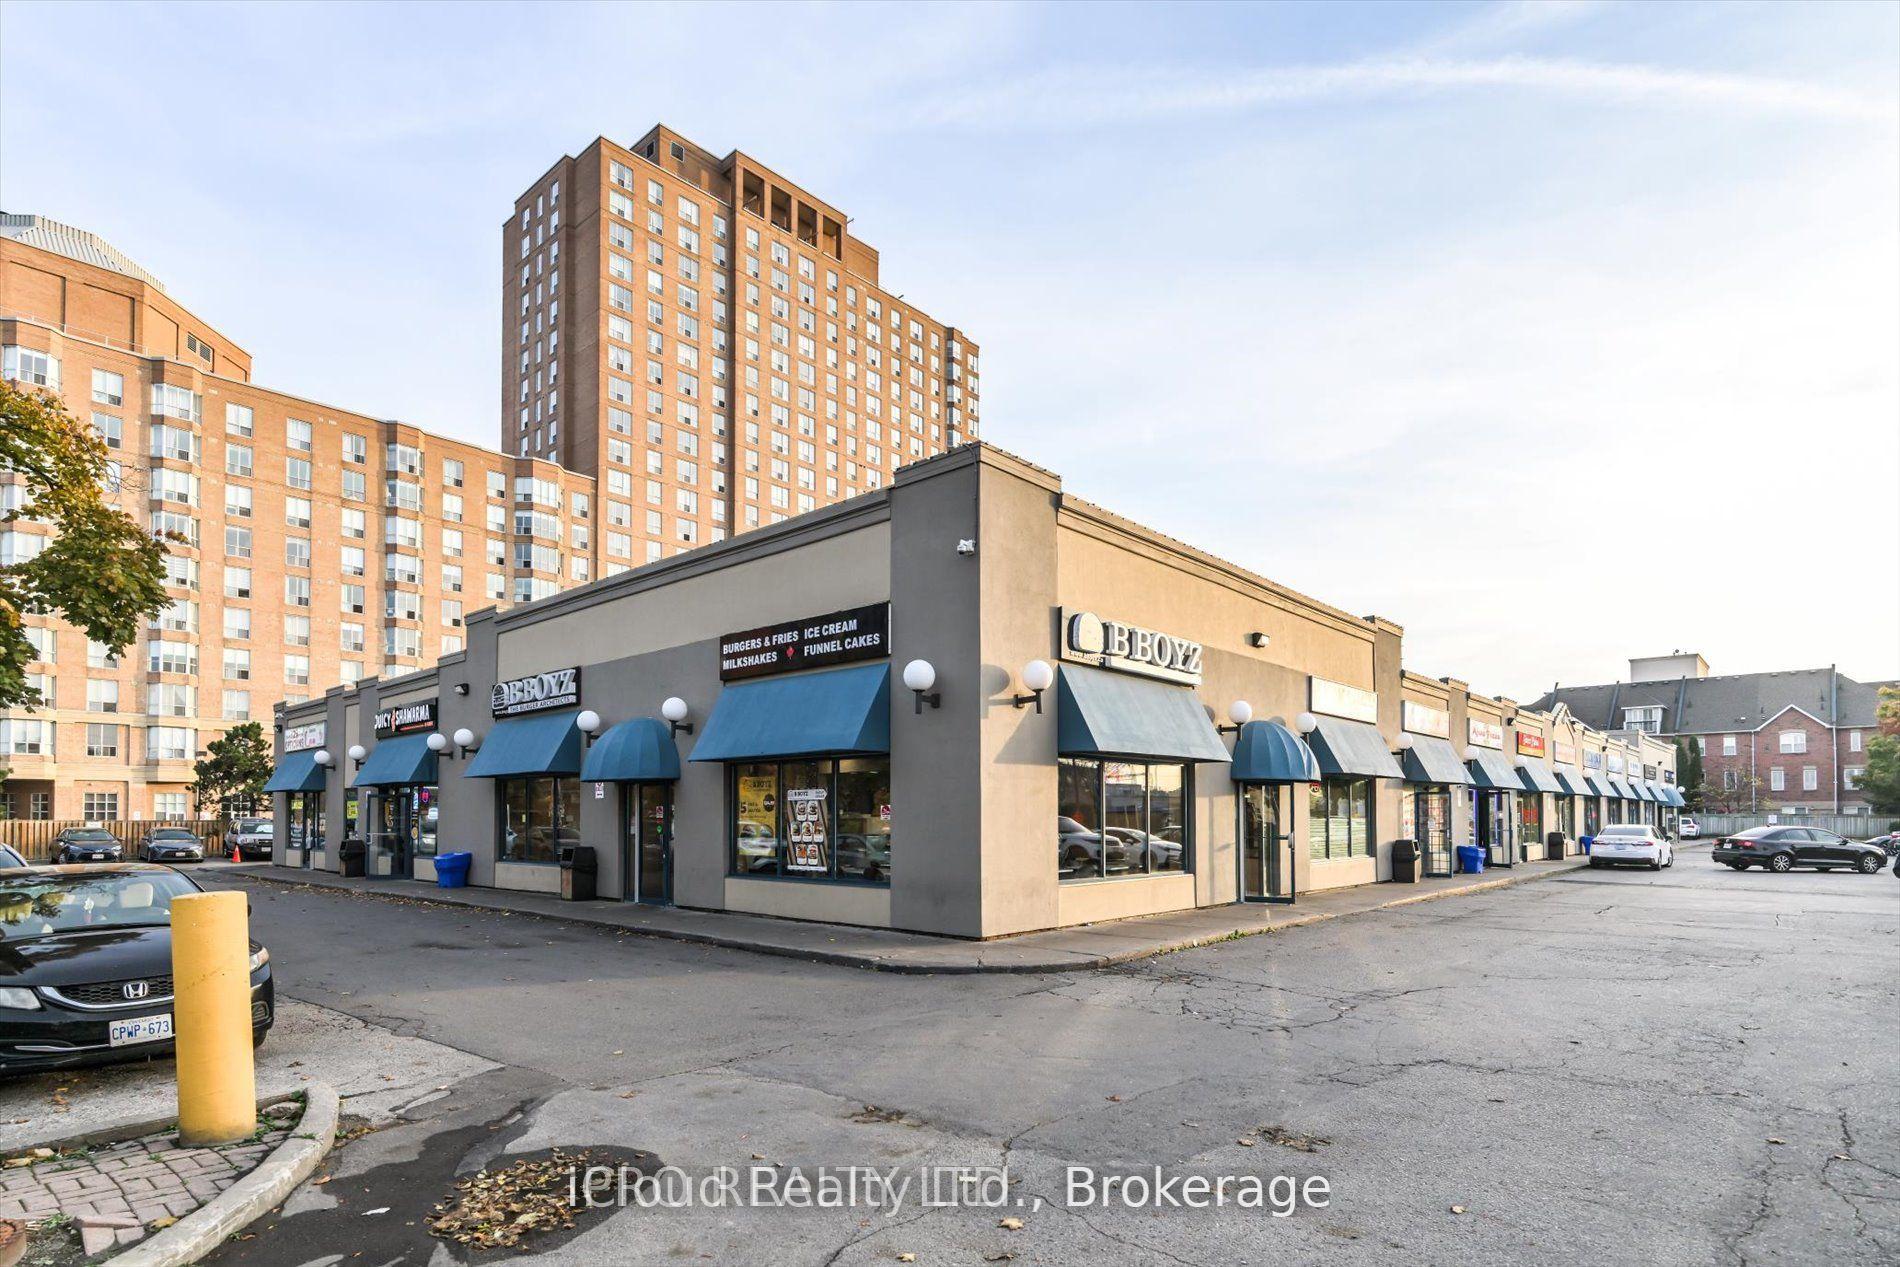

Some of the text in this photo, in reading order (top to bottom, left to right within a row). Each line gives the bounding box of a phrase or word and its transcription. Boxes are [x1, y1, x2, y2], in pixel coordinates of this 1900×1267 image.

[723, 619, 858, 655] BURGERS & FRIES ICE CREAM
[723, 633, 880, 670] MILKSHAKES FUNNEL CAKES
[374, 712, 391, 730] JUICY
[395, 704, 430, 726] SHAWARMA
[112, 1024, 140, 1040] CPWP
[148, 1020, 169, 1034] 673
